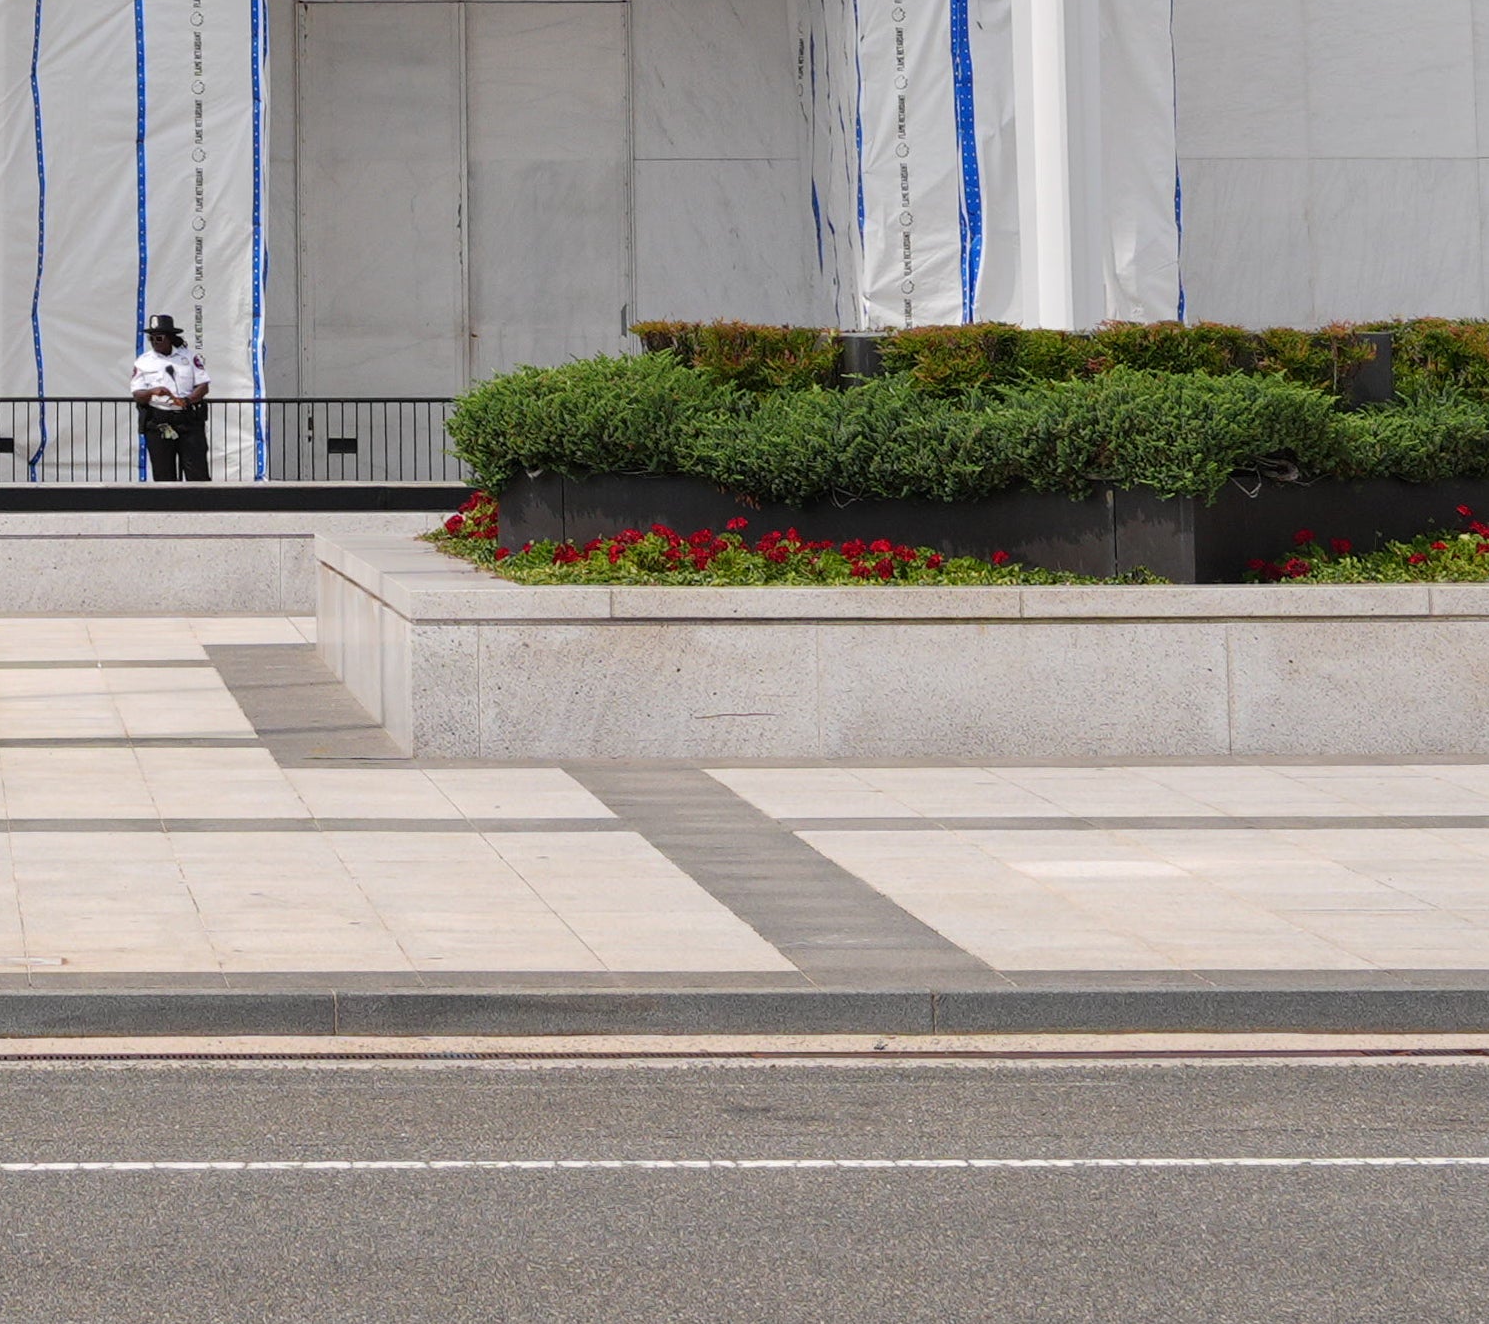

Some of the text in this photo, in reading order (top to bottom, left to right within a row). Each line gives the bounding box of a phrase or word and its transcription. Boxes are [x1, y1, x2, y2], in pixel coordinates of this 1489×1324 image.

[193, 61, 202, 76] FLAME
[896, 57, 904, 72] FLAME
[195, 197, 203, 212] FLAME
[901, 193, 909, 208] FLAME
[195, 266, 203, 281] FLAME
[903, 261, 911, 276] FLAME
[194, 335, 203, 350] FLAME
